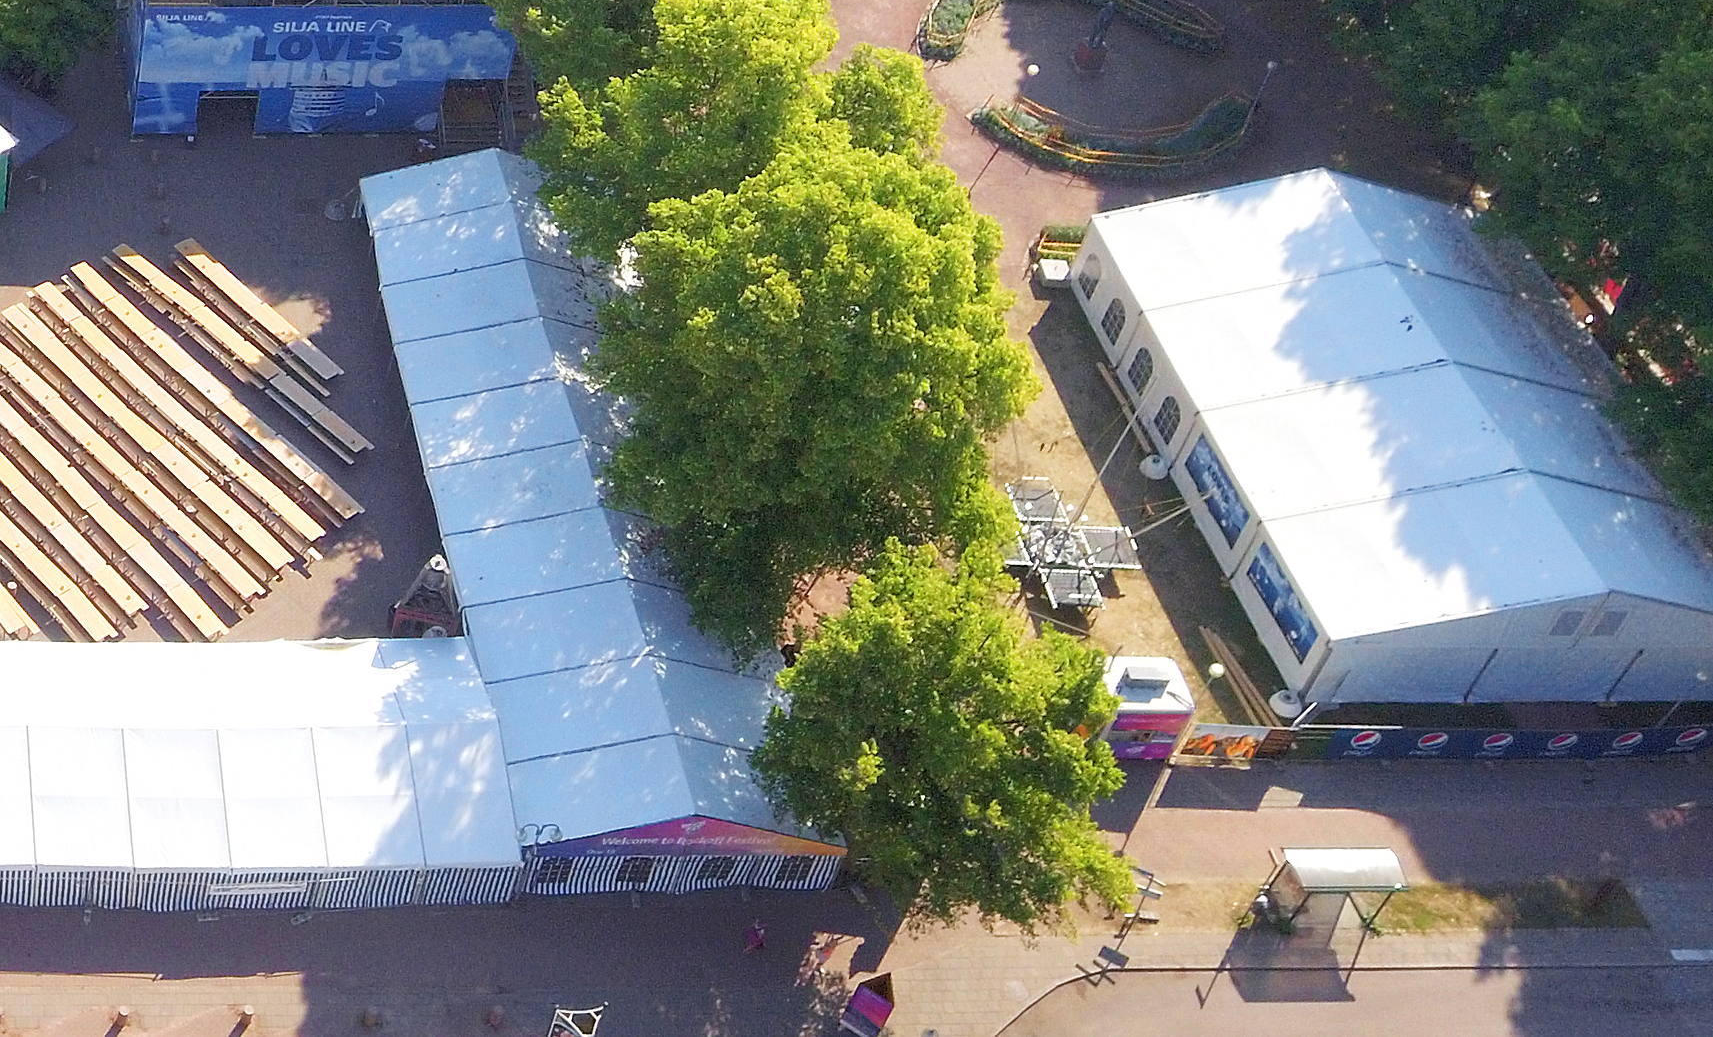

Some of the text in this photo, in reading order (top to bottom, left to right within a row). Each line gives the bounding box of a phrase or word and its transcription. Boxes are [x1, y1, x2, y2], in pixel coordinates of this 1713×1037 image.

[273, 21, 367, 33] SILJA LINE
[251, 34, 405, 62] LOVES
[246, 61, 401, 88] MUSIC
[602, 836, 659, 846] Welcome
[661, 837, 675, 845] to
